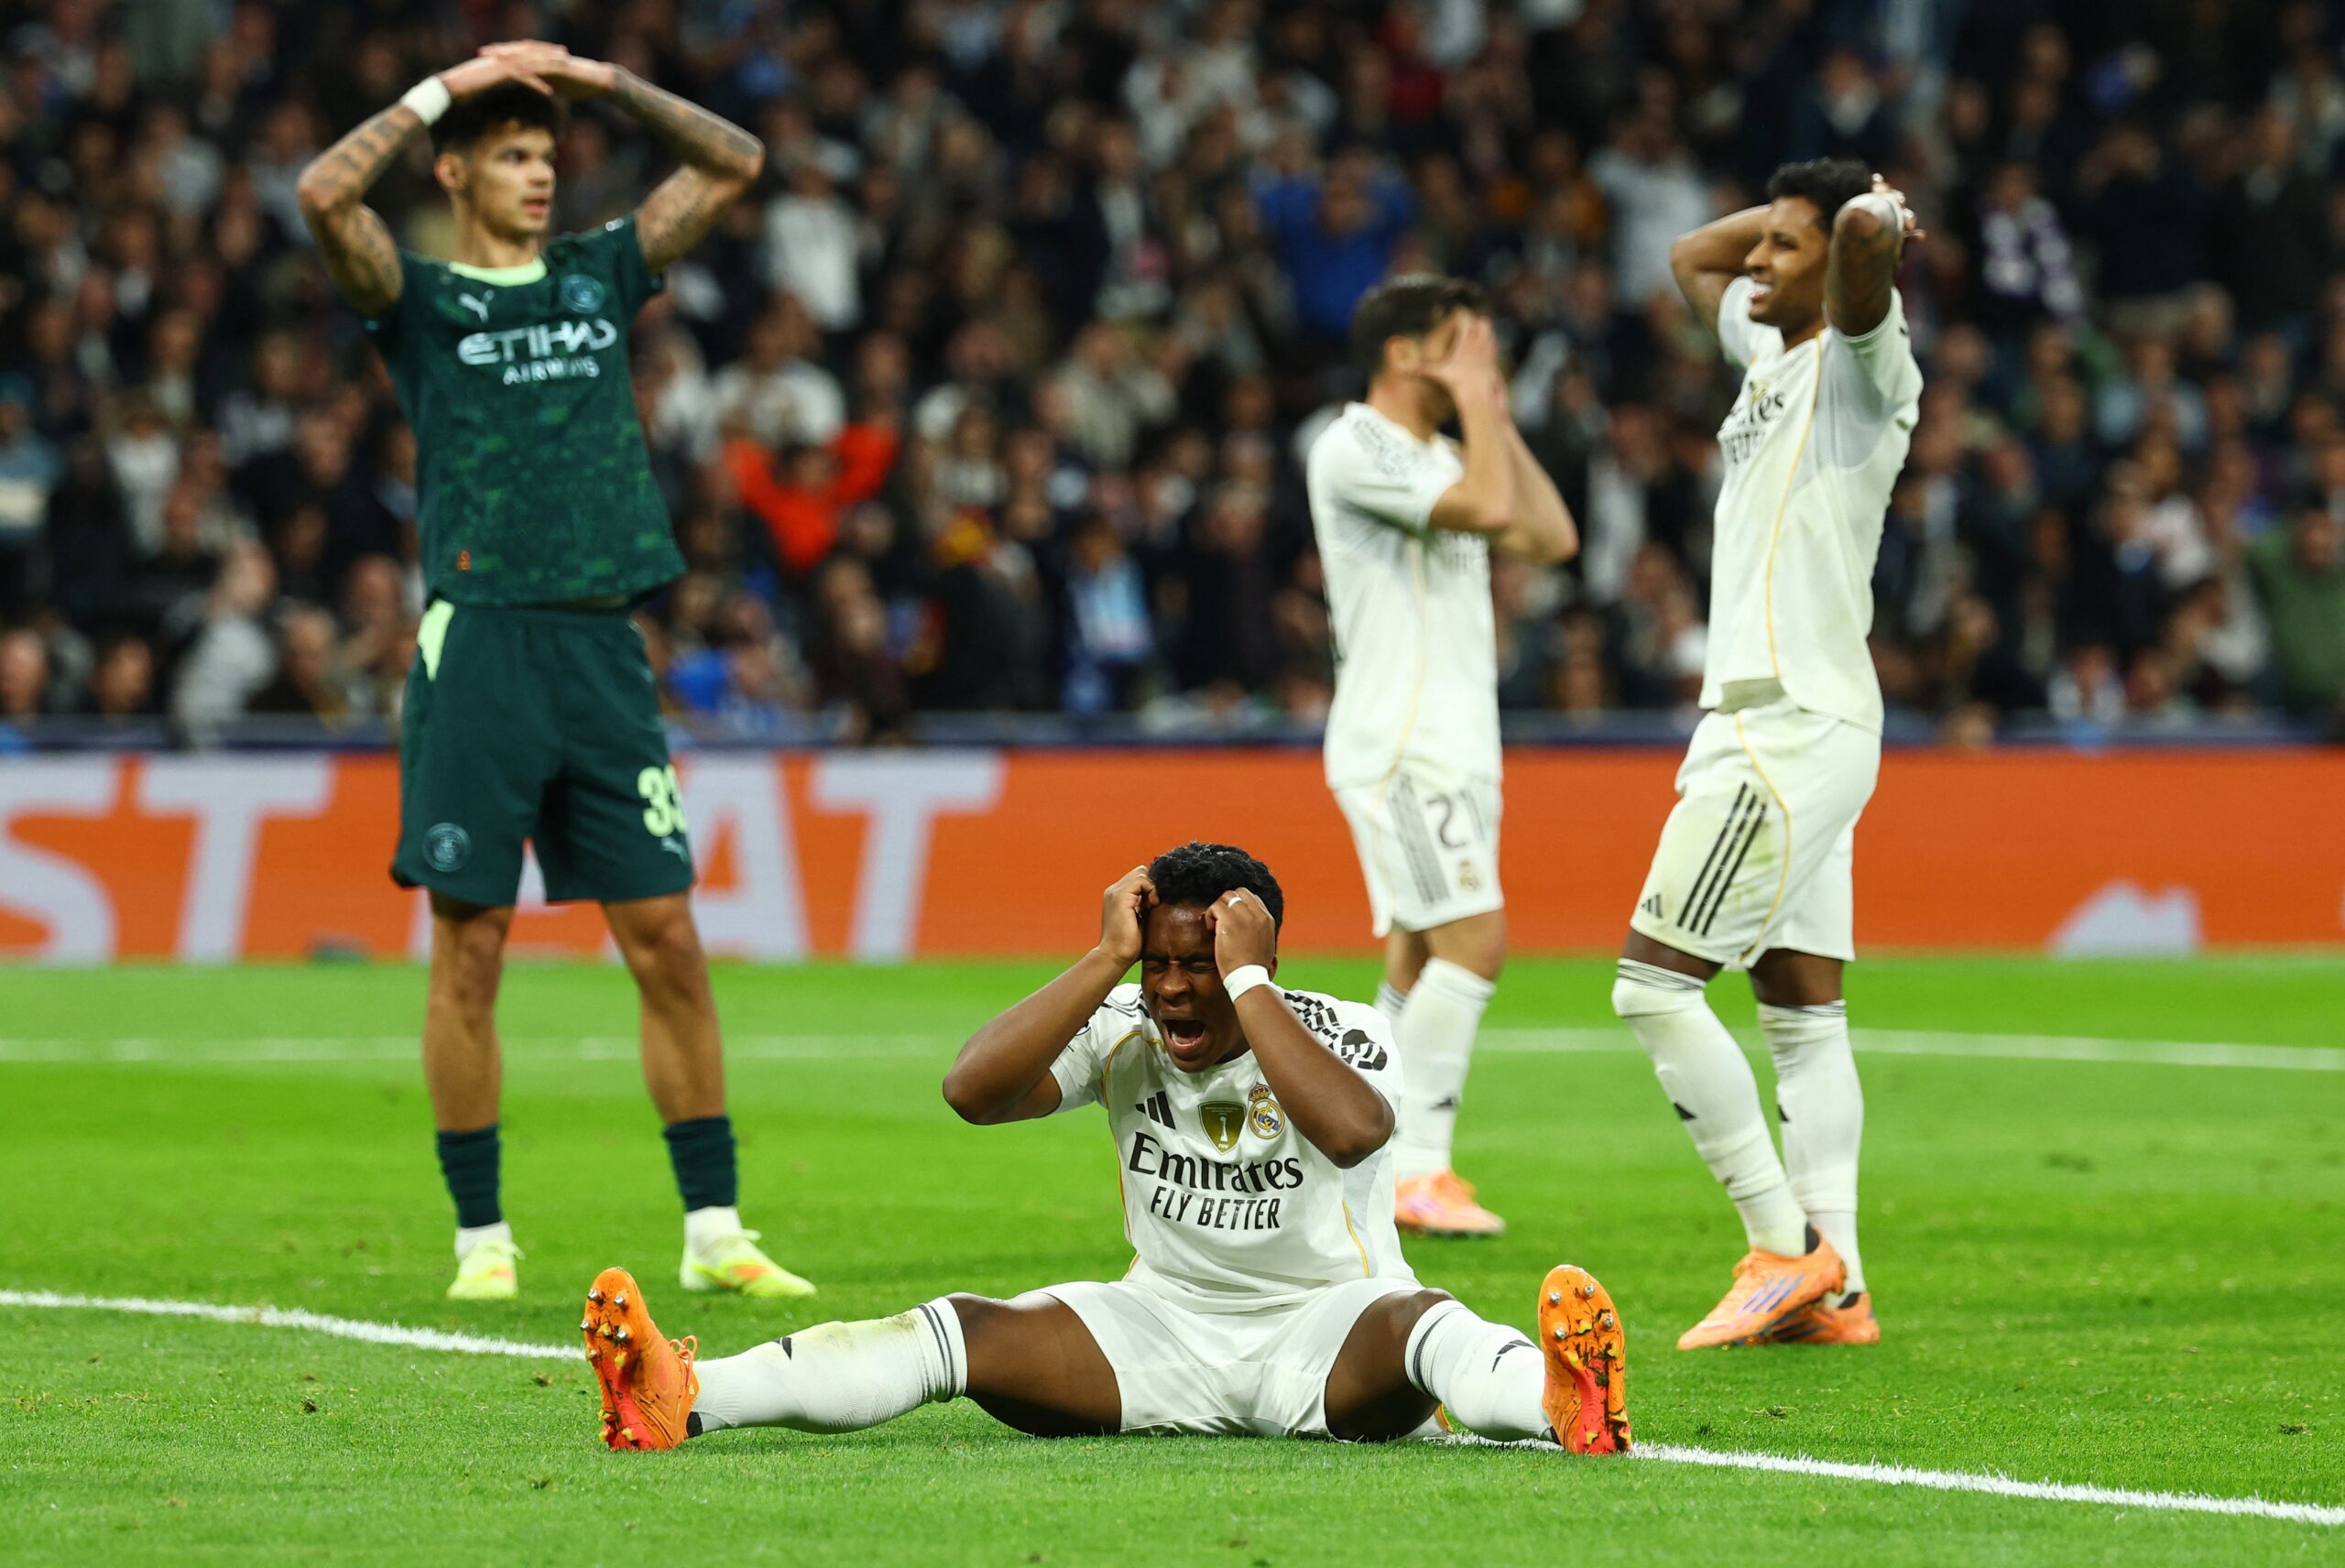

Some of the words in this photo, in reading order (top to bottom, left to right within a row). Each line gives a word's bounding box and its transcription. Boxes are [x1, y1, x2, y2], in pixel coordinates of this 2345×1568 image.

[456, 318, 618, 366] ETIHAD
[1129, 1131, 1303, 1194] Emirates
[1151, 1185, 1193, 1222] FLY
[1196, 1197, 1282, 1230] BETTER
